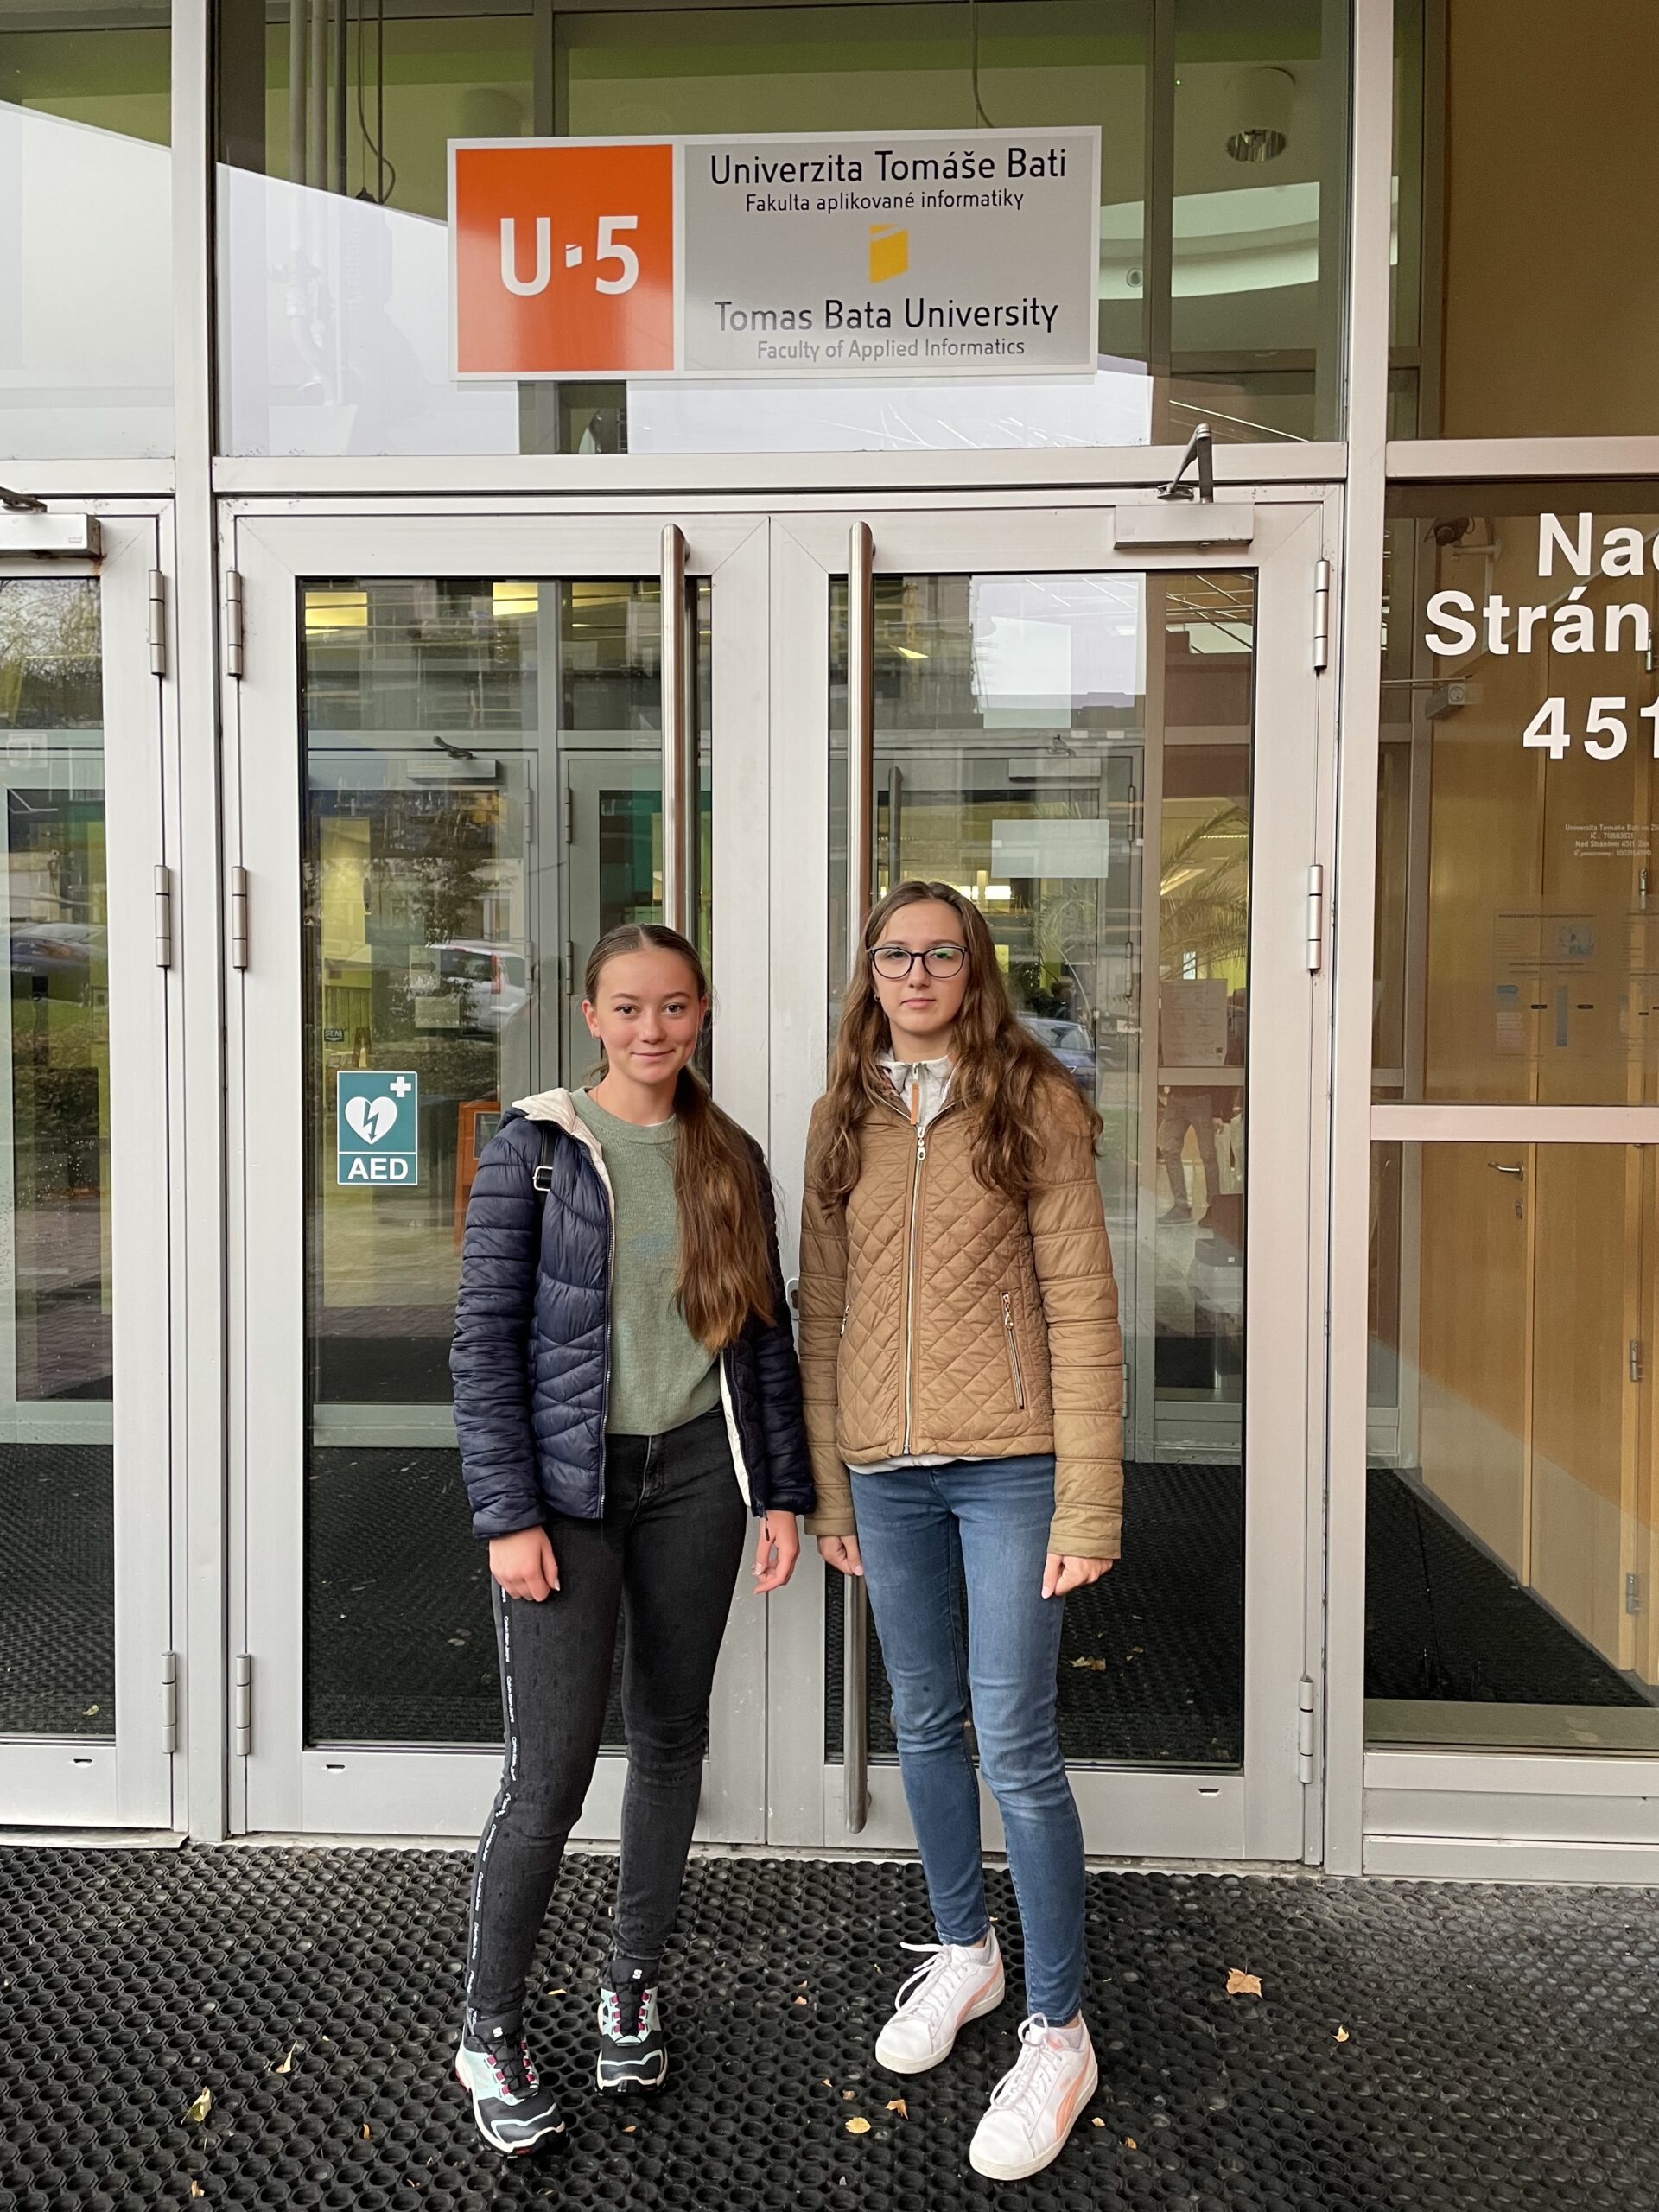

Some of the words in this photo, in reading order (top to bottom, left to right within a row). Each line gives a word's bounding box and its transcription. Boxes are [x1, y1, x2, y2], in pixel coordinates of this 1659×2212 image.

[711, 153, 862, 185] Univerzita
[874, 149, 995, 181] Tomáše
[1007, 147, 1065, 178] Bati
[746, 193, 810, 213] Fakulta
[817, 191, 915, 213] aplikované
[921, 188, 1025, 211] informatiky
[714, 301, 813, 332] Tomas
[825, 299, 892, 330] Bata
[905, 296, 1058, 334] University
[757, 340, 821, 363] Faculty
[825, 339, 845, 359] of
[848, 338, 918, 361] Applied
[925, 337, 1026, 357] Informatics
[1538, 512, 1659, 577] Na
[1425, 586, 1649, 656] Strán
[347, 1157, 409, 1180] AED
